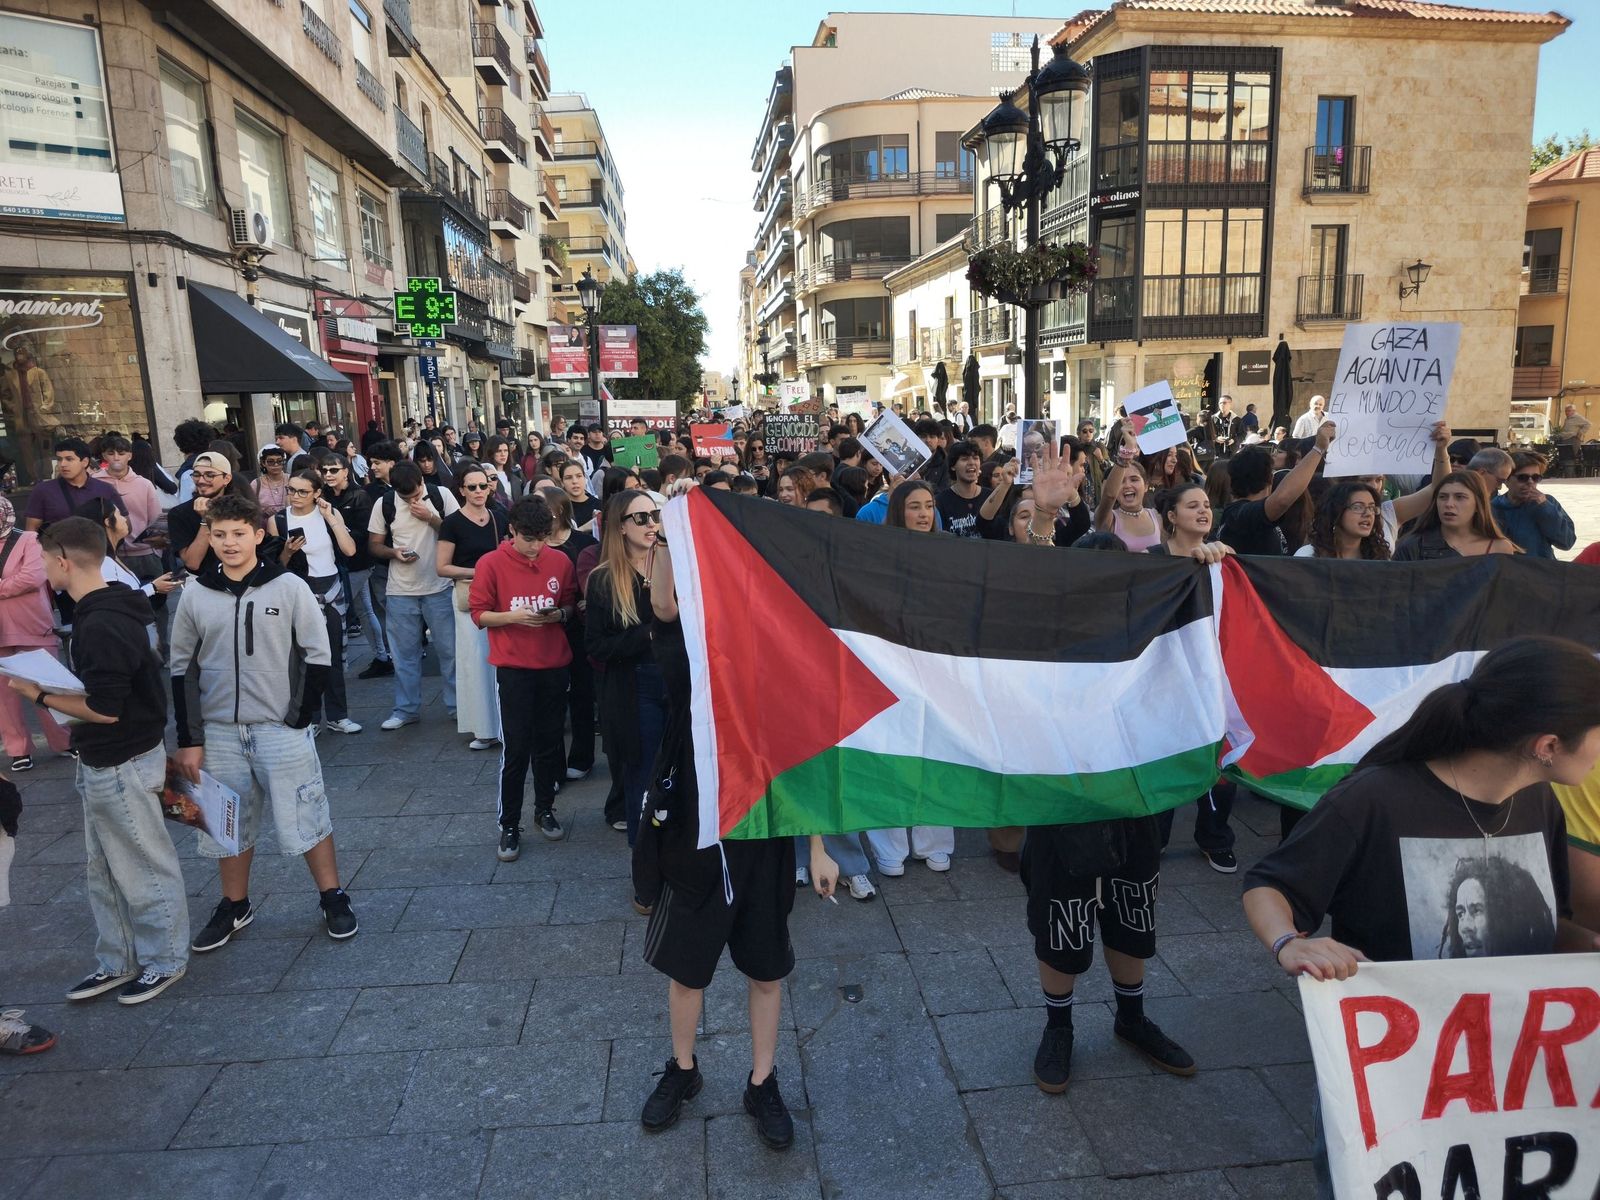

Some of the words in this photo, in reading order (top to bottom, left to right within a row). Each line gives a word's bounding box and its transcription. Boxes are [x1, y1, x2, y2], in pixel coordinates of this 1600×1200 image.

[35, 77, 66, 89] Parejas
[1091, 190, 1140, 207] piccolinos
[1371, 326, 1429, 352] GAZA
[1343, 356, 1442, 386] AGUANTA
[1330, 393, 1348, 414] EL
[1359, 389, 1417, 414] MUNDO
[1416, 391, 1443, 415] SE
[656, 417, 675, 428] OLÉ
[804, 415, 815, 423] EL
[766, 437, 776, 445] ES
[1331, 417, 1434, 464] levanta
[695, 446, 736, 456] PALESTINA
[765, 445, 779, 453] SER
